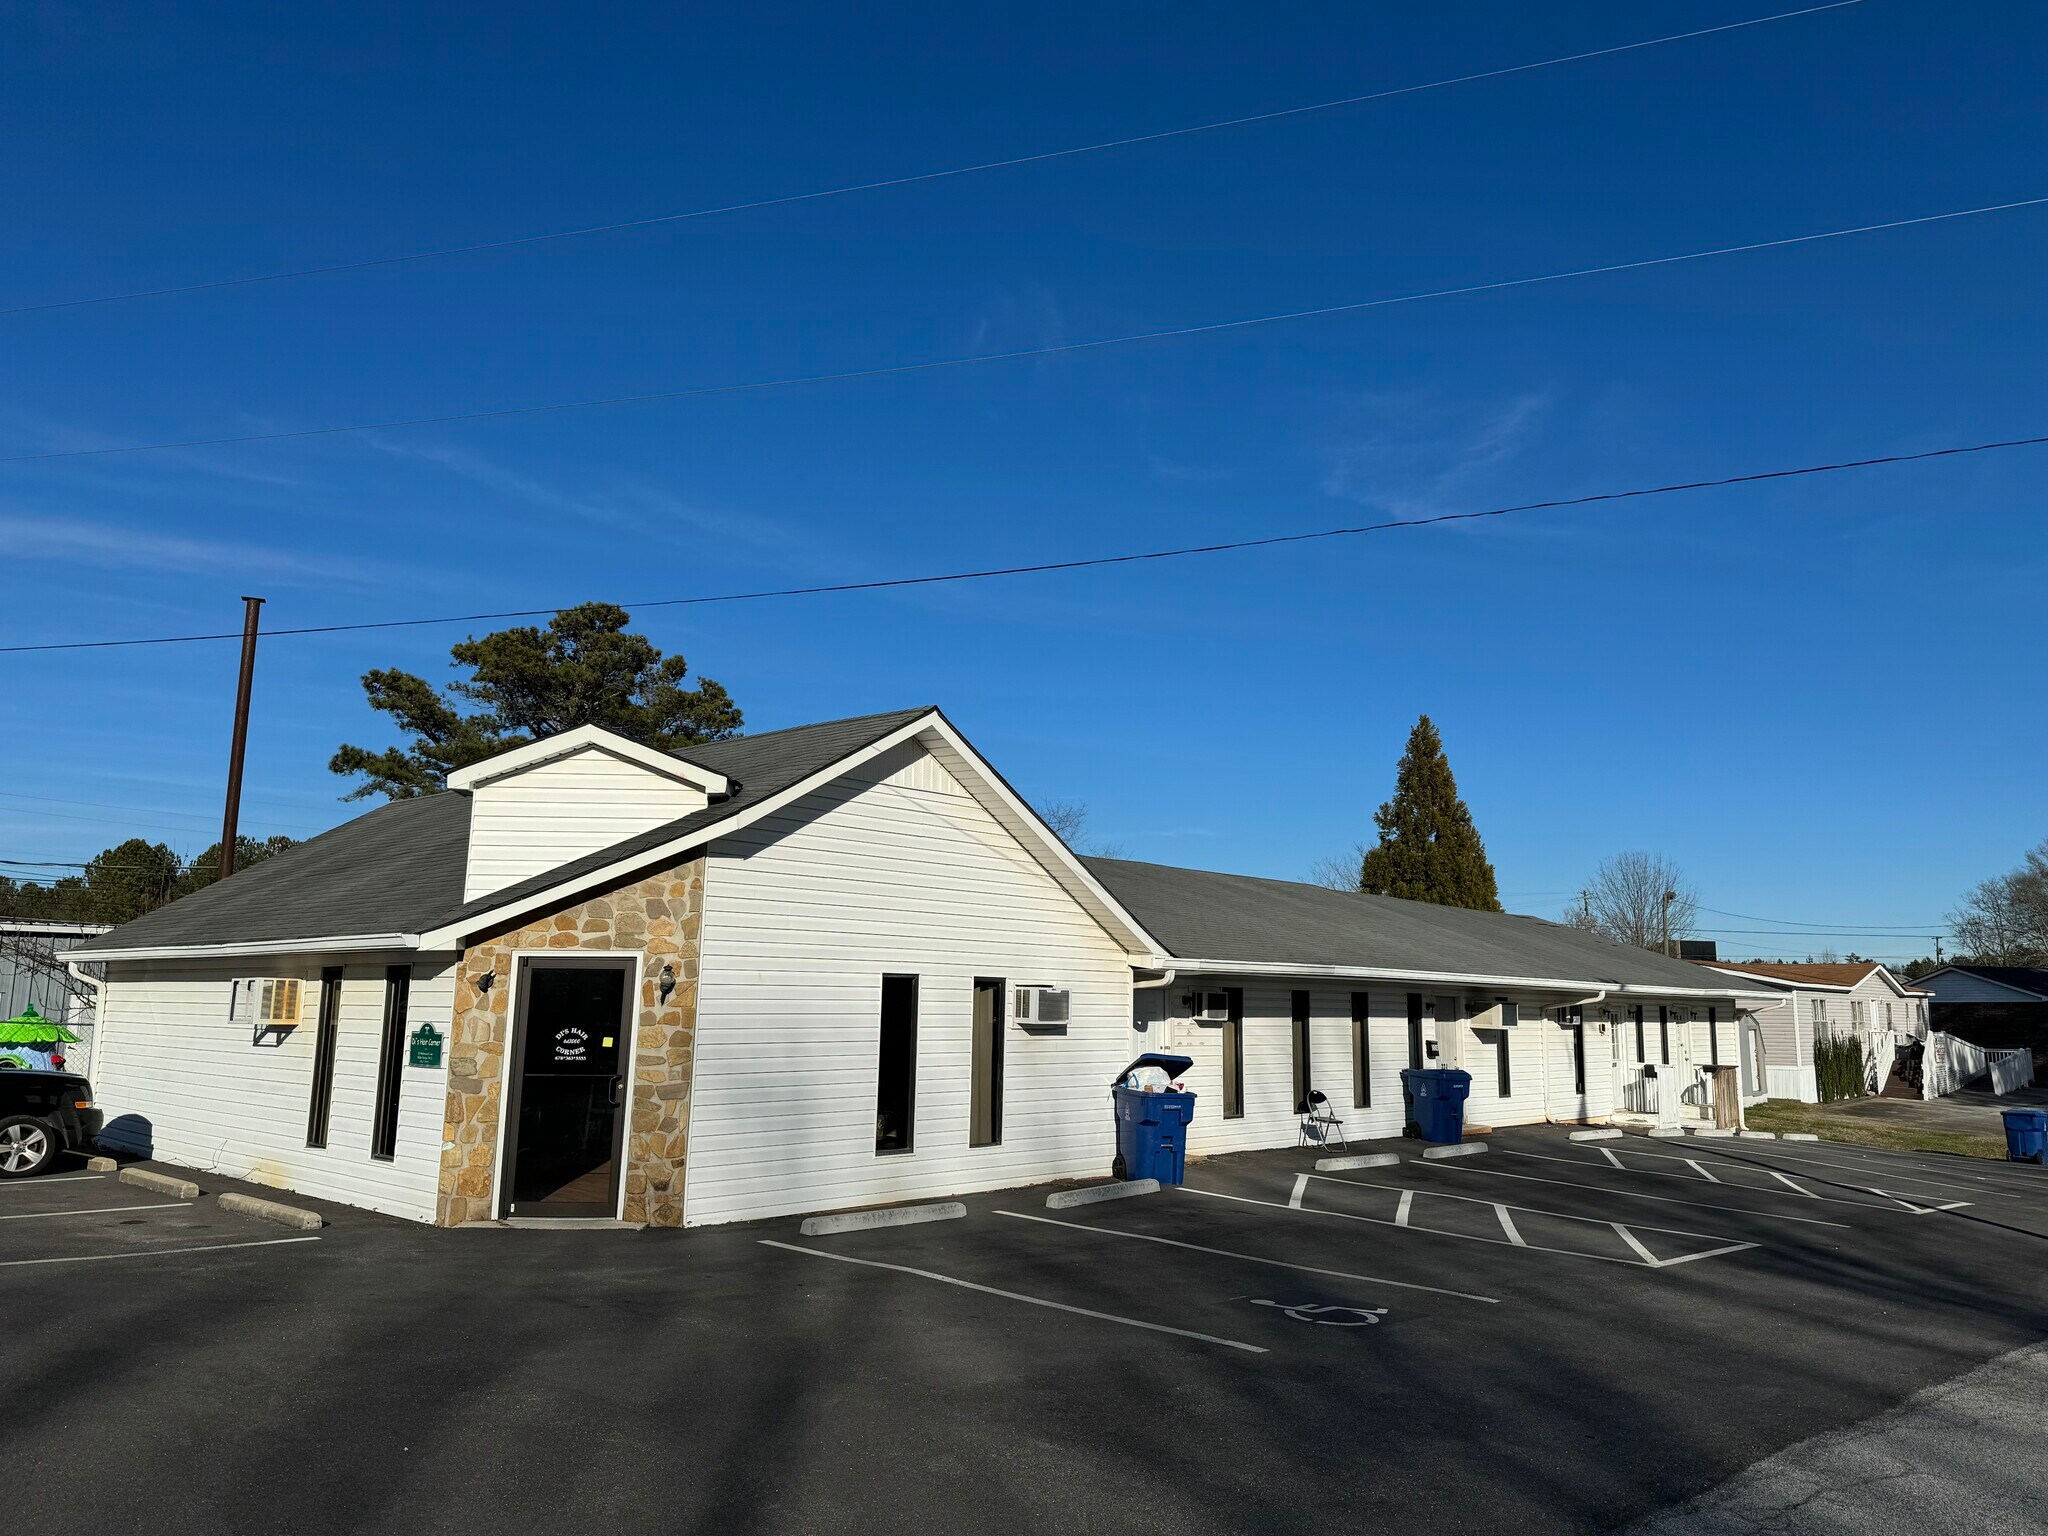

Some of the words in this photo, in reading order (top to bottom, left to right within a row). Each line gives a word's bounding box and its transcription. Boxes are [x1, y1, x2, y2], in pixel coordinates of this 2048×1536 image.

[555, 1028, 570, 1040] DI'S
[571, 1027, 589, 1040] HAIR
[555, 1045, 586, 1055] CORNER
